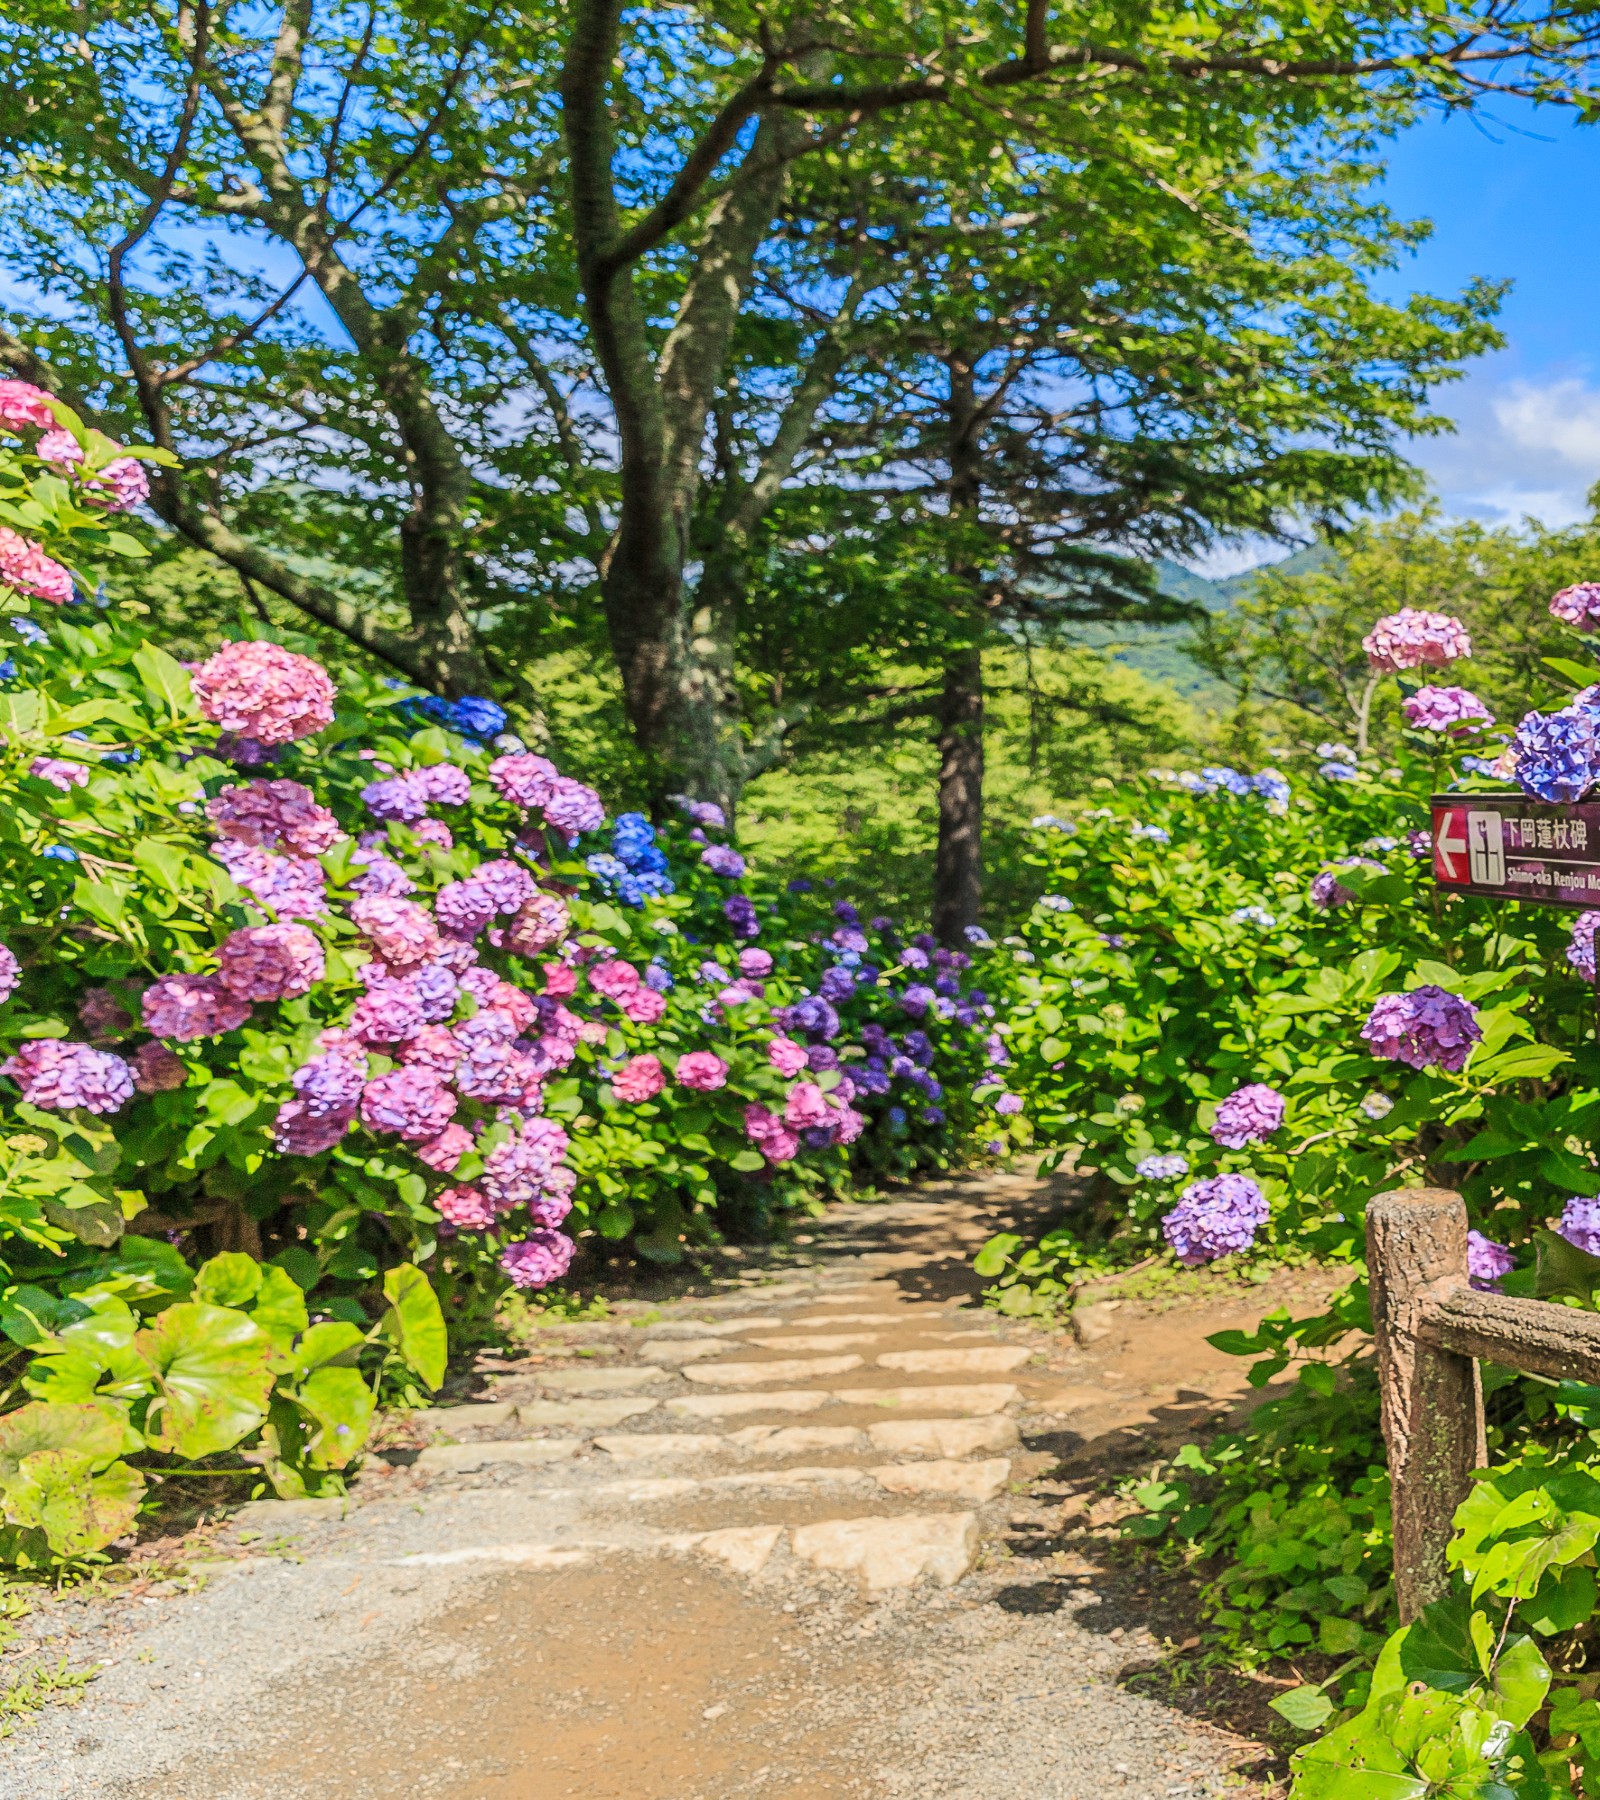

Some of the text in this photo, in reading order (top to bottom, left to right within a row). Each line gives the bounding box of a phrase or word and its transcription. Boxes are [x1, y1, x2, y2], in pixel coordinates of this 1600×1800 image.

[1504, 818, 1588, 851] 下岡蓮杖碑
[1507, 867, 1552, 886] Shimo-oka
[1553, 871, 1585, 891] Renjou
